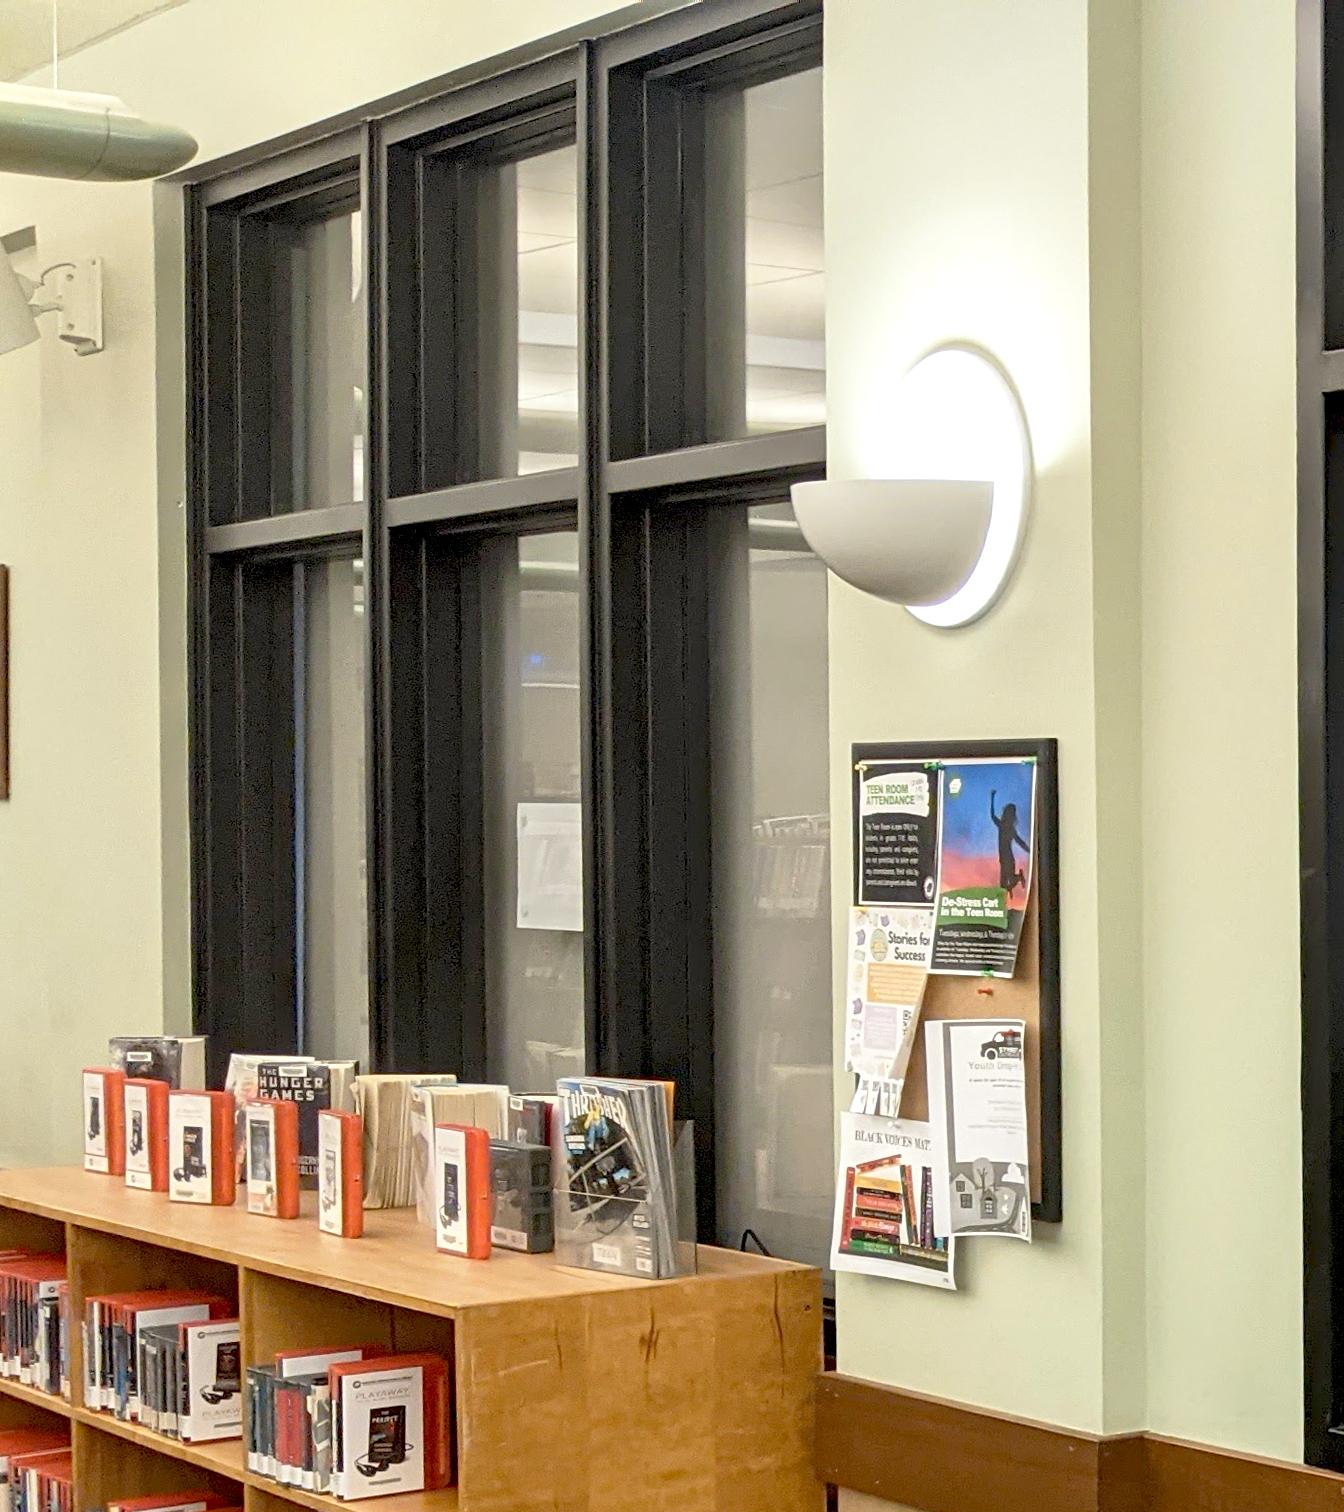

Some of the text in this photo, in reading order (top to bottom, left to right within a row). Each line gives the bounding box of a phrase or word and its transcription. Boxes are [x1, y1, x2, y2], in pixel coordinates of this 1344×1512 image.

[866, 785, 883, 794] TEEN
[886, 784, 908, 794] ROOM
[866, 795, 915, 805] ATTENDANCE
[888, 931, 917, 946] Stories
[895, 947, 926, 961] Success
[262, 1068, 277, 1076] THE
[259, 1077, 323, 1089] HUNGER
[260, 1089, 315, 1101] GAMES
[855, 1130, 883, 1145] BLACK
[885, 1133, 912, 1148] VOICES
